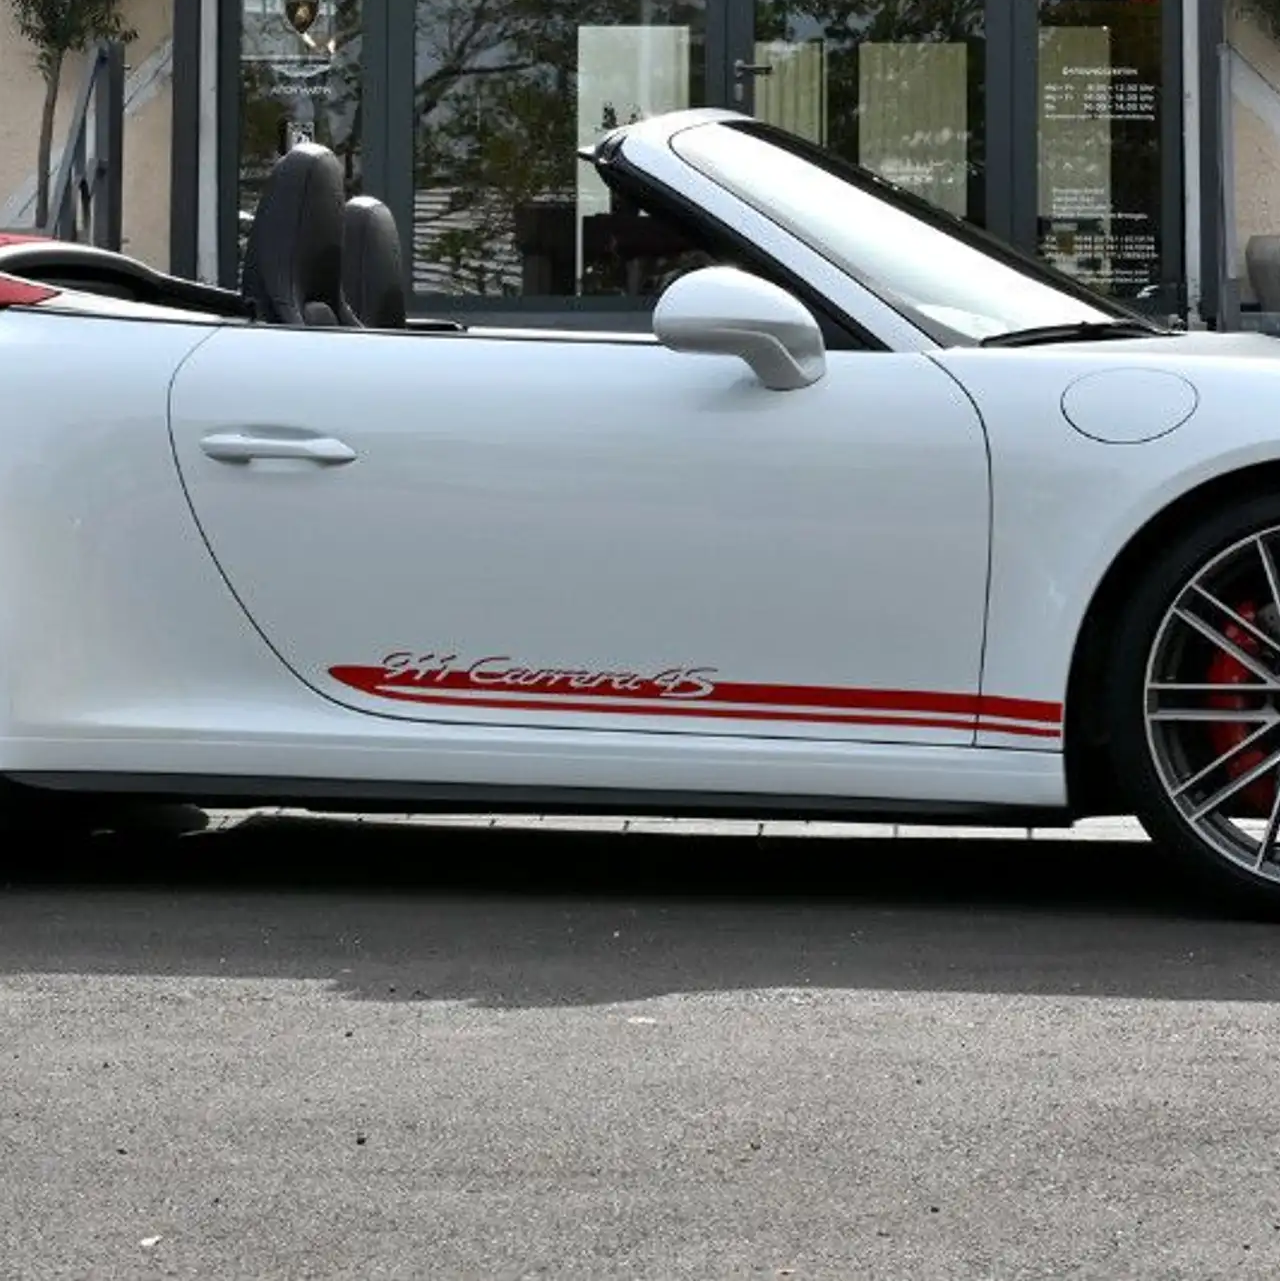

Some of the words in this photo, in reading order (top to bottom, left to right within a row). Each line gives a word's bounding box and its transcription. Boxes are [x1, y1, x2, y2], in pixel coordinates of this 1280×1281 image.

[382, 652, 457, 682] 911
[469, 656, 641, 690] Carrera
[650, 667, 719, 698] 4S
